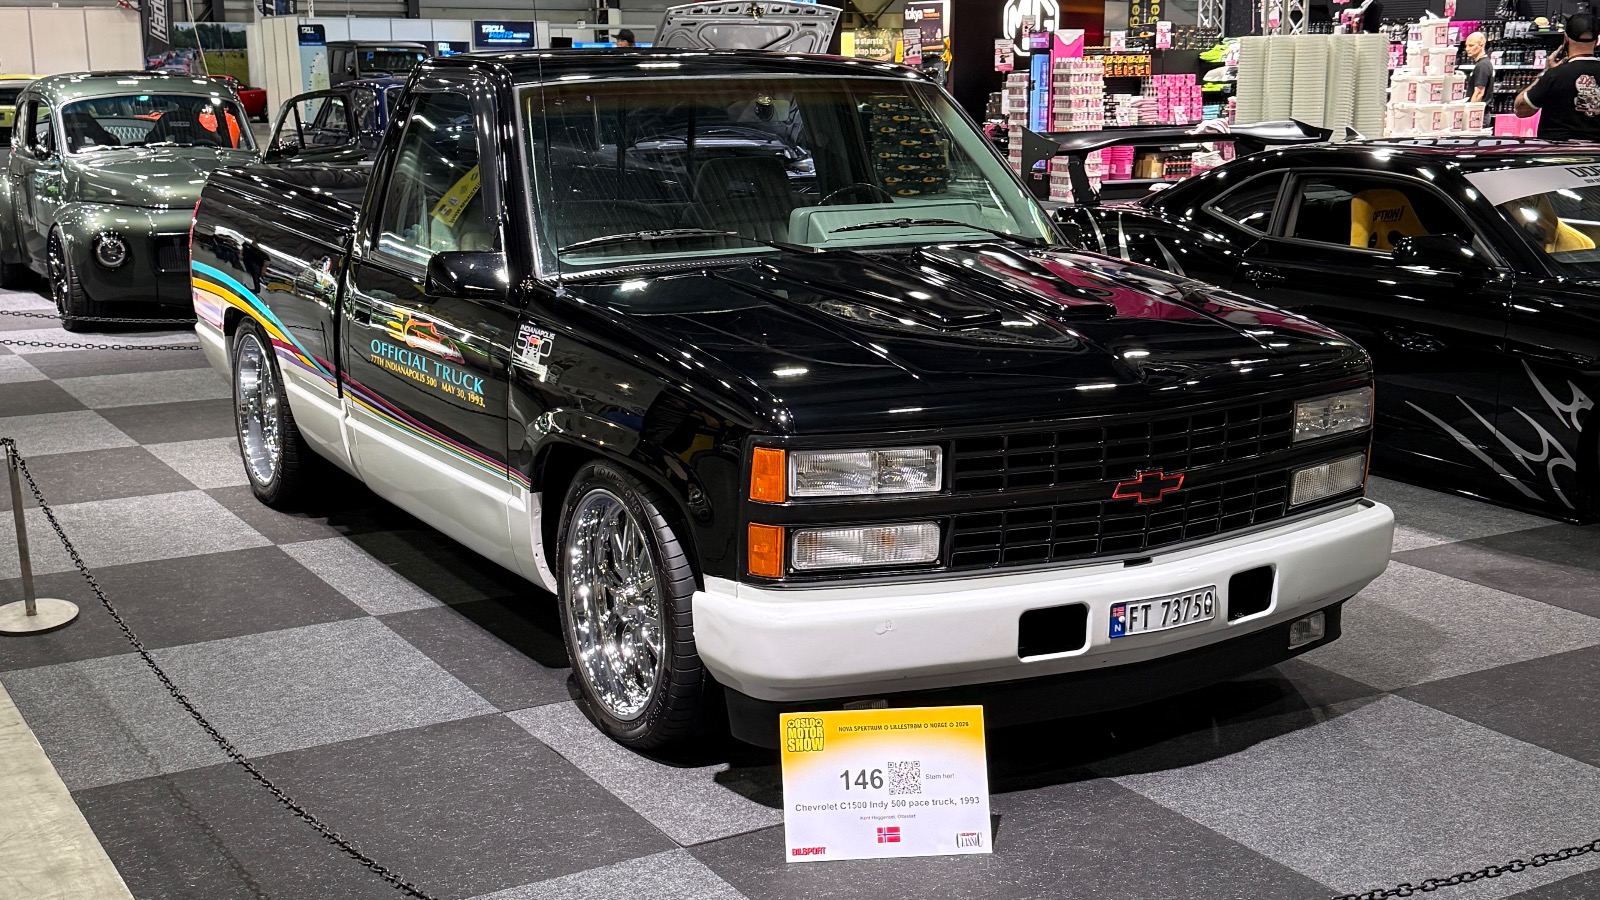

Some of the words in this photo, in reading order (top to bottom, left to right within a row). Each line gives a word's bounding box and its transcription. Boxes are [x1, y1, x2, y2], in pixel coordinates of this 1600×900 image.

[519, 324, 556, 340] INDIANAPOLIS
[370, 339, 429, 373] OFFICIAL
[434, 361, 485, 395] TRUCK
[370, 354, 385, 366] 77TH
[385, 359, 426, 383] INDIANAPOLIS
[426, 373, 438, 388] 500
[441, 384, 455, 396] MAY
[456, 388, 467, 401] 30,
[1128, 605, 1152, 633] FT
[1161, 591, 1214, 628] 73750
[1114, 624, 1122, 633] N
[795, 718, 816, 728] OSLO
[854, 724, 883, 732] SPEKTRUM
[787, 726, 824, 739] MOTOR
[787, 737, 824, 752] SHOW
[840, 768, 884, 790] 146
[795, 803, 838, 812] Chevrolet
[840, 801, 868, 810] C1500
[869, 801, 888, 810] Indy
[891, 799, 906, 807] 500
[908, 800, 930, 808] pace
[932, 798, 957, 806] truck,
[960, 796, 980, 805] 1993
[792, 847, 826, 856] BILSPORT
